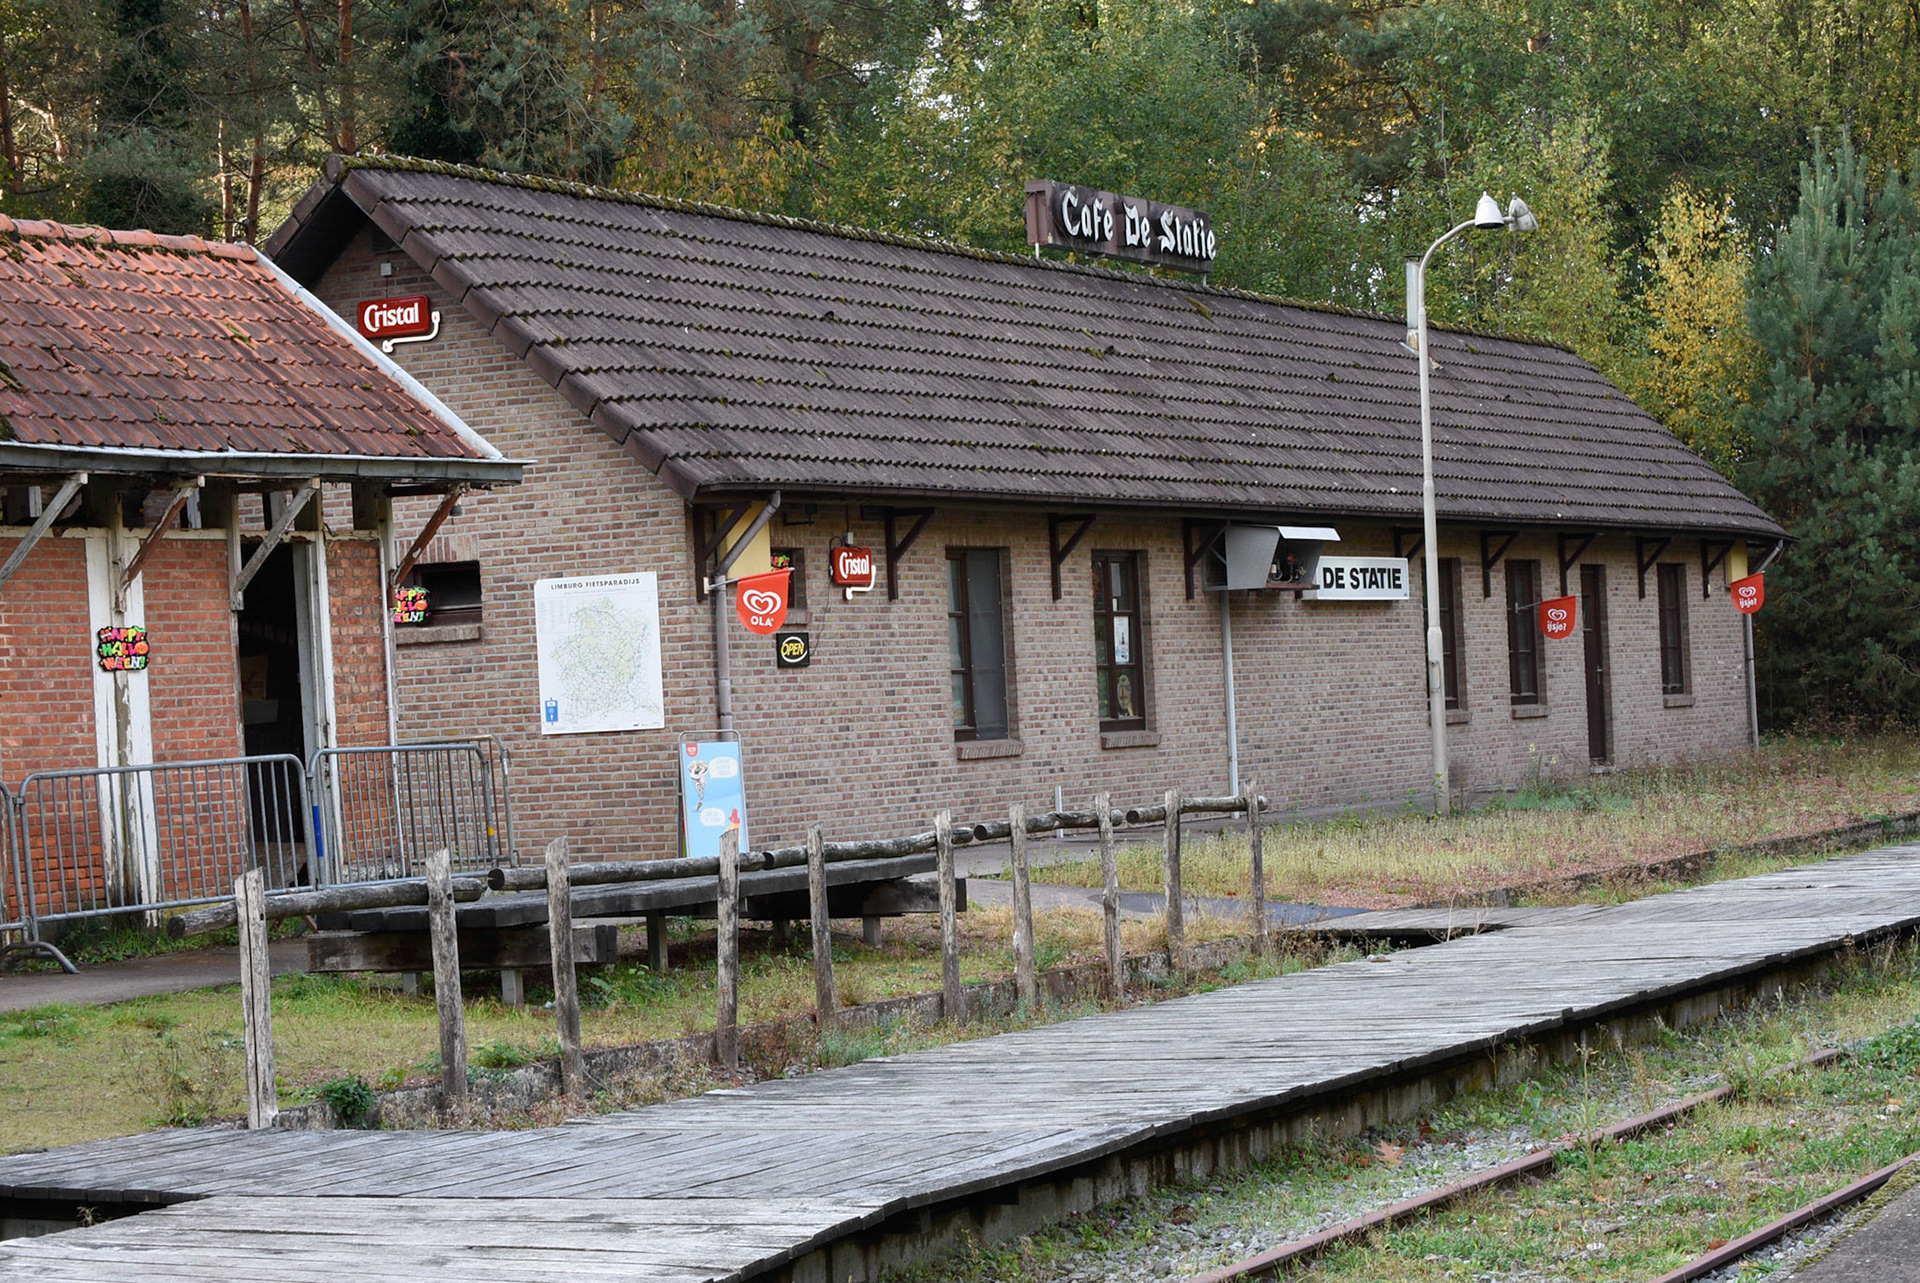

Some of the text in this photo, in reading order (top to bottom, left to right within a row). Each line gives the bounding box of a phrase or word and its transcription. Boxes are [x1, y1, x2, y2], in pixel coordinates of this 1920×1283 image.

[1061, 189, 1217, 261] Cafe De Statie
[363, 302, 420, 333] Cristal
[839, 551, 870, 579] Cristal
[550, 577, 641, 591] LIMBURG FIETSPARADIJS
[1322, 566, 1402, 590] DE STATIE
[750, 615, 773, 627] OLA
[100, 625, 146, 642] HAPPY
[780, 642, 805, 656] OPEN
[102, 655, 147, 670] WEEN!
